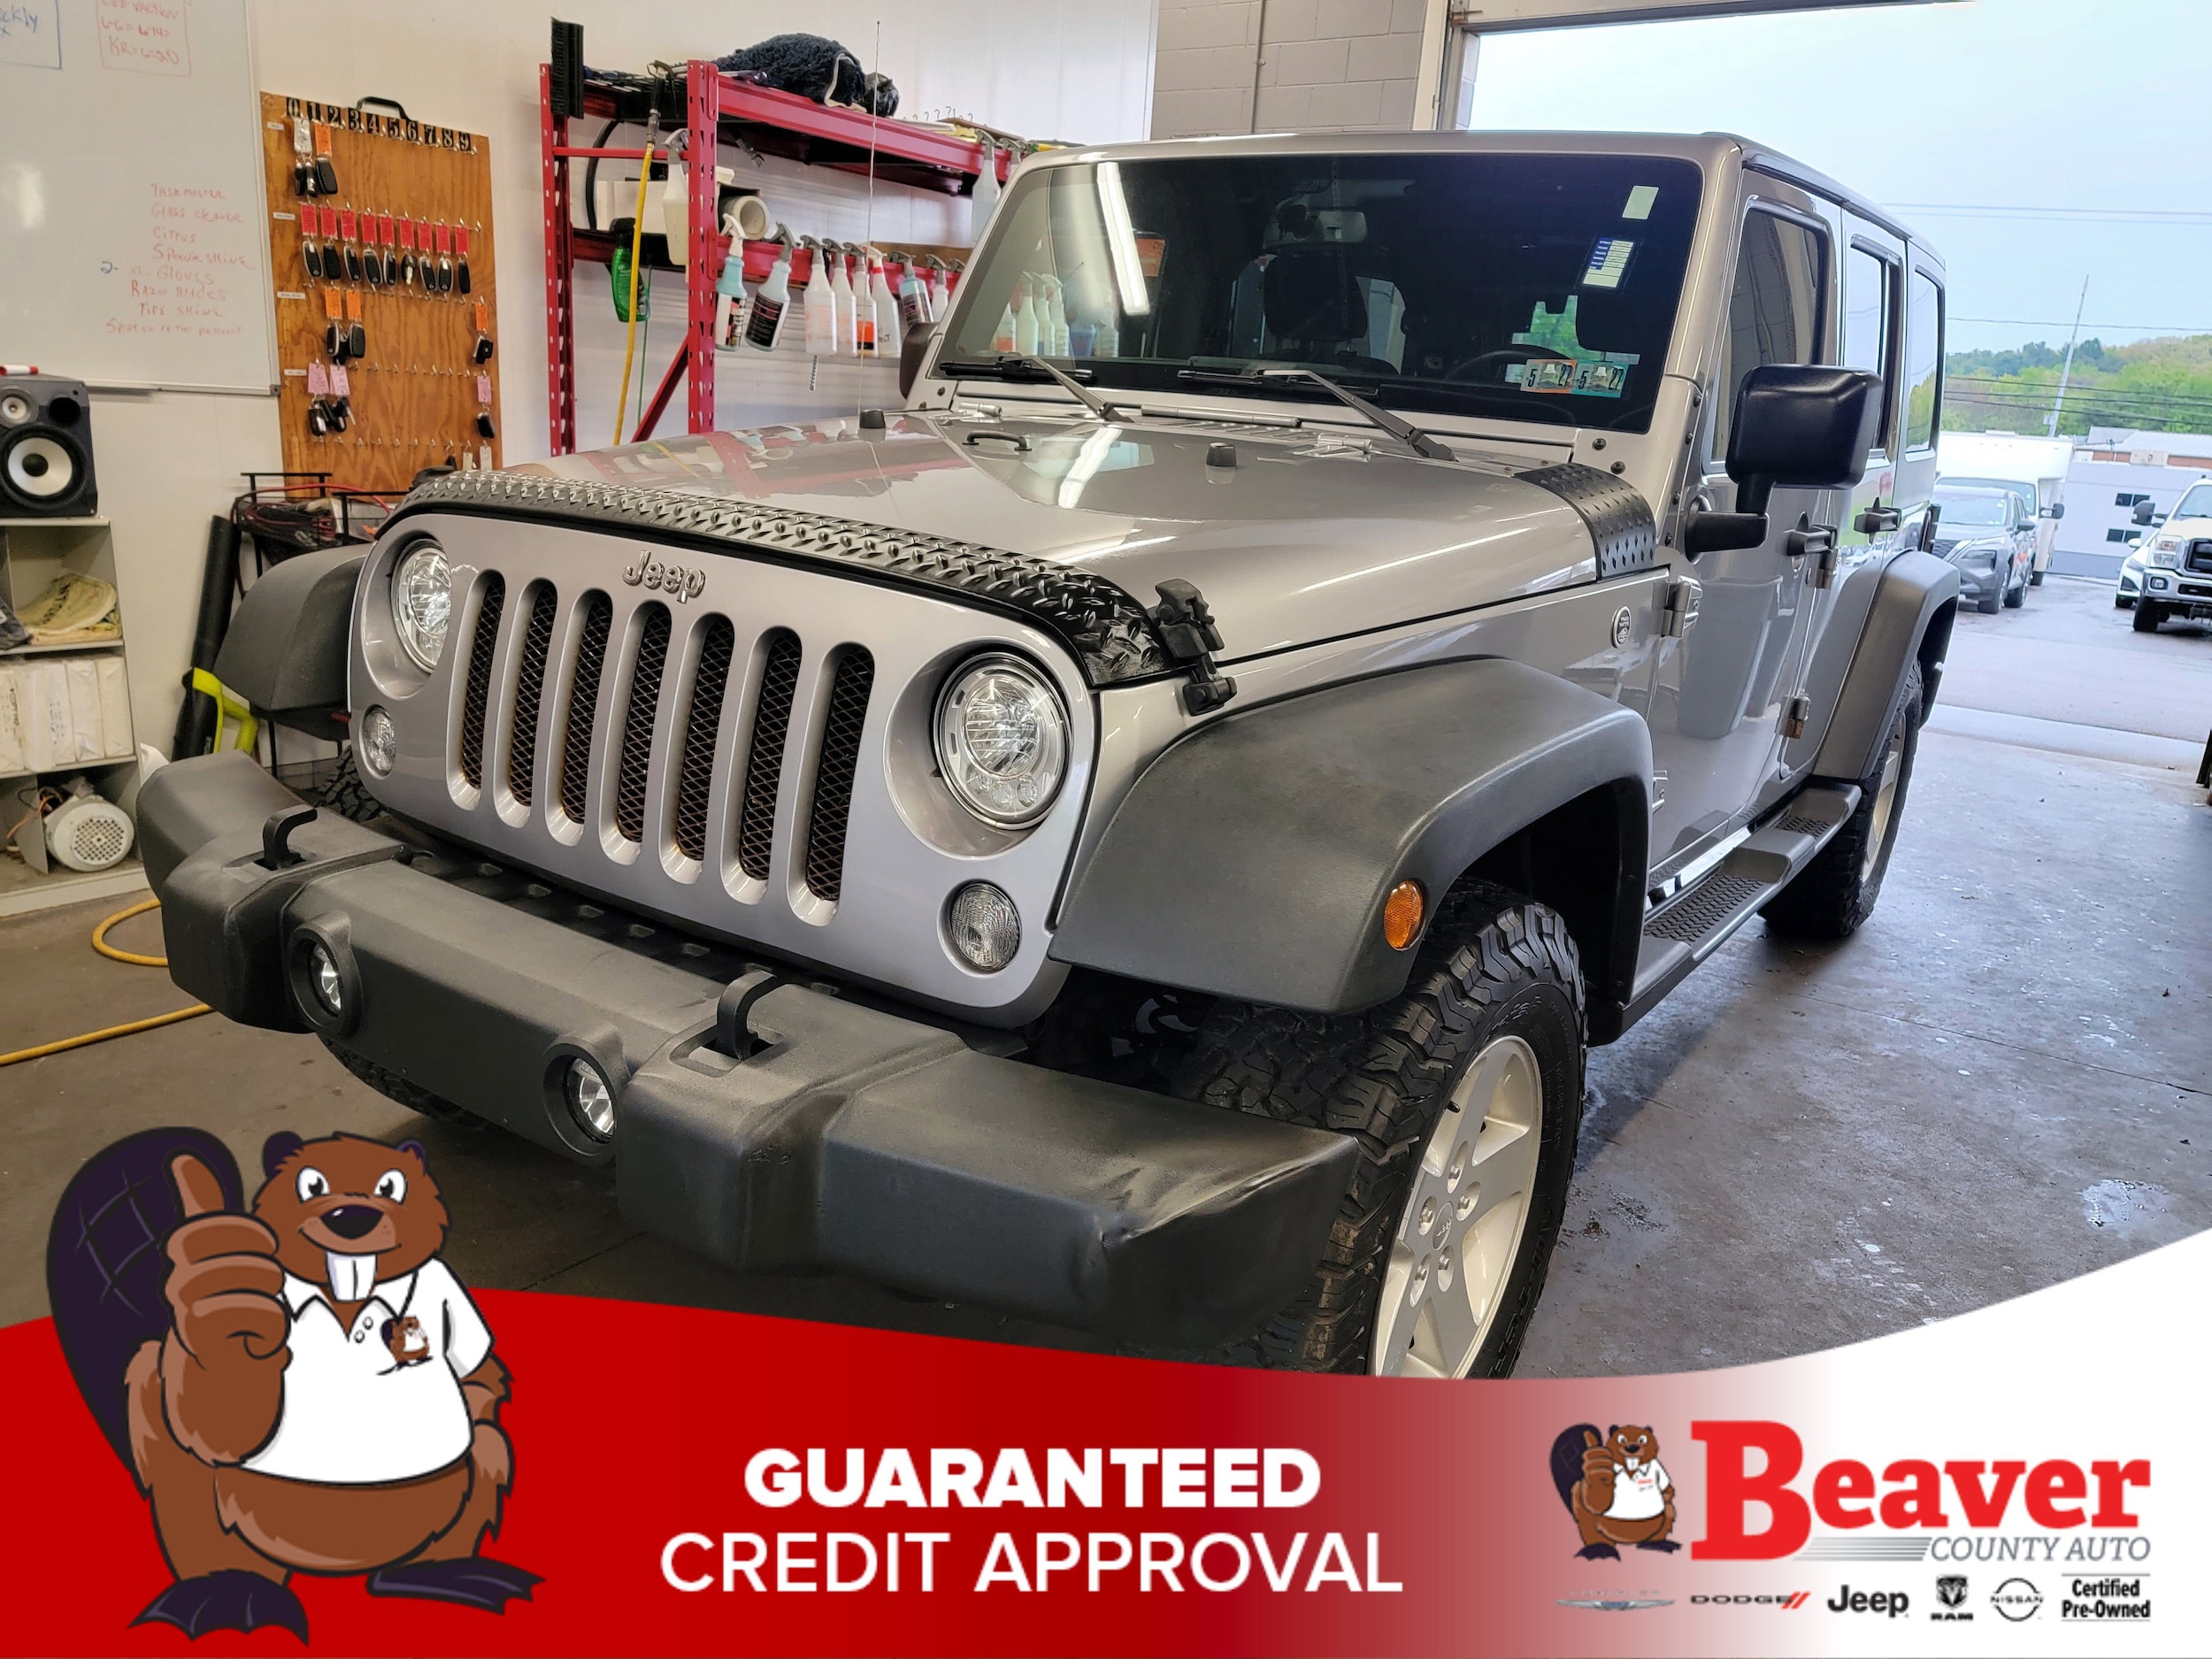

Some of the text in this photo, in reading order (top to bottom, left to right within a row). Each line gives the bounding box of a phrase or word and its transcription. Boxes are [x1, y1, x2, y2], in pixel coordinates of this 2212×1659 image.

[288, 98, 472, 151] 0 1 2 3 4 5 6 7 8 9
[1527, 368, 1538, 388] 5
[622, 549, 706, 604] Jeep
